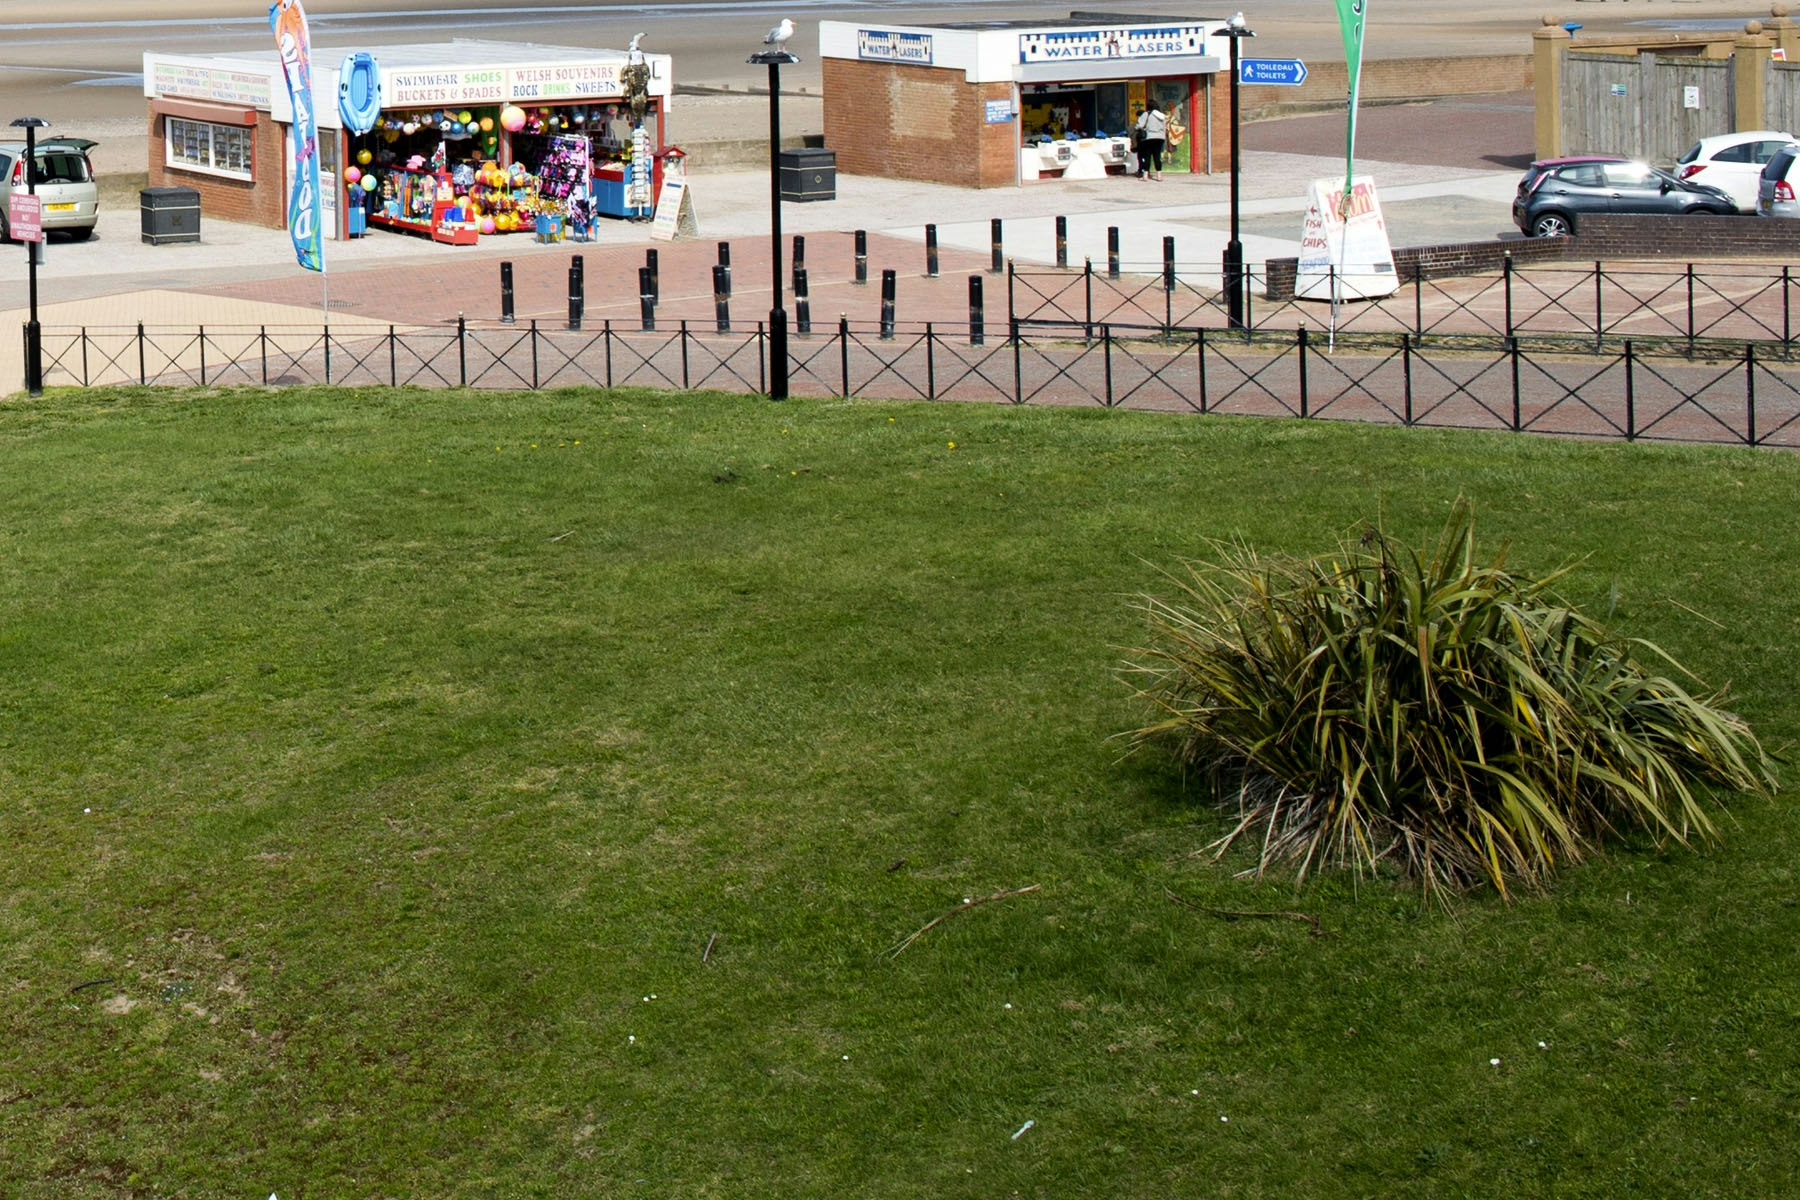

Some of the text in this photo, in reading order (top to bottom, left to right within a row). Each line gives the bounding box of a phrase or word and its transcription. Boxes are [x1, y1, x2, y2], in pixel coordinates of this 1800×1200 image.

[868, 45, 922, 57] WATER LASERS
[1044, 41, 1183, 57] WATER LASERS
[516, 66, 613, 82] WELSH SOUVENIRS
[1256, 63, 1293, 71] TOILEDAU
[396, 71, 502, 87] SWIMWEAR SHOES
[1256, 72, 1286, 80] TOILETS
[397, 88, 446, 102] BUCKETS
[462, 86, 501, 99] SPADES
[513, 80, 616, 97] ROCK DRINKS SWEETS
[1305, 219, 1322, 228] FISH
[1302, 237, 1327, 249] CHIPS
